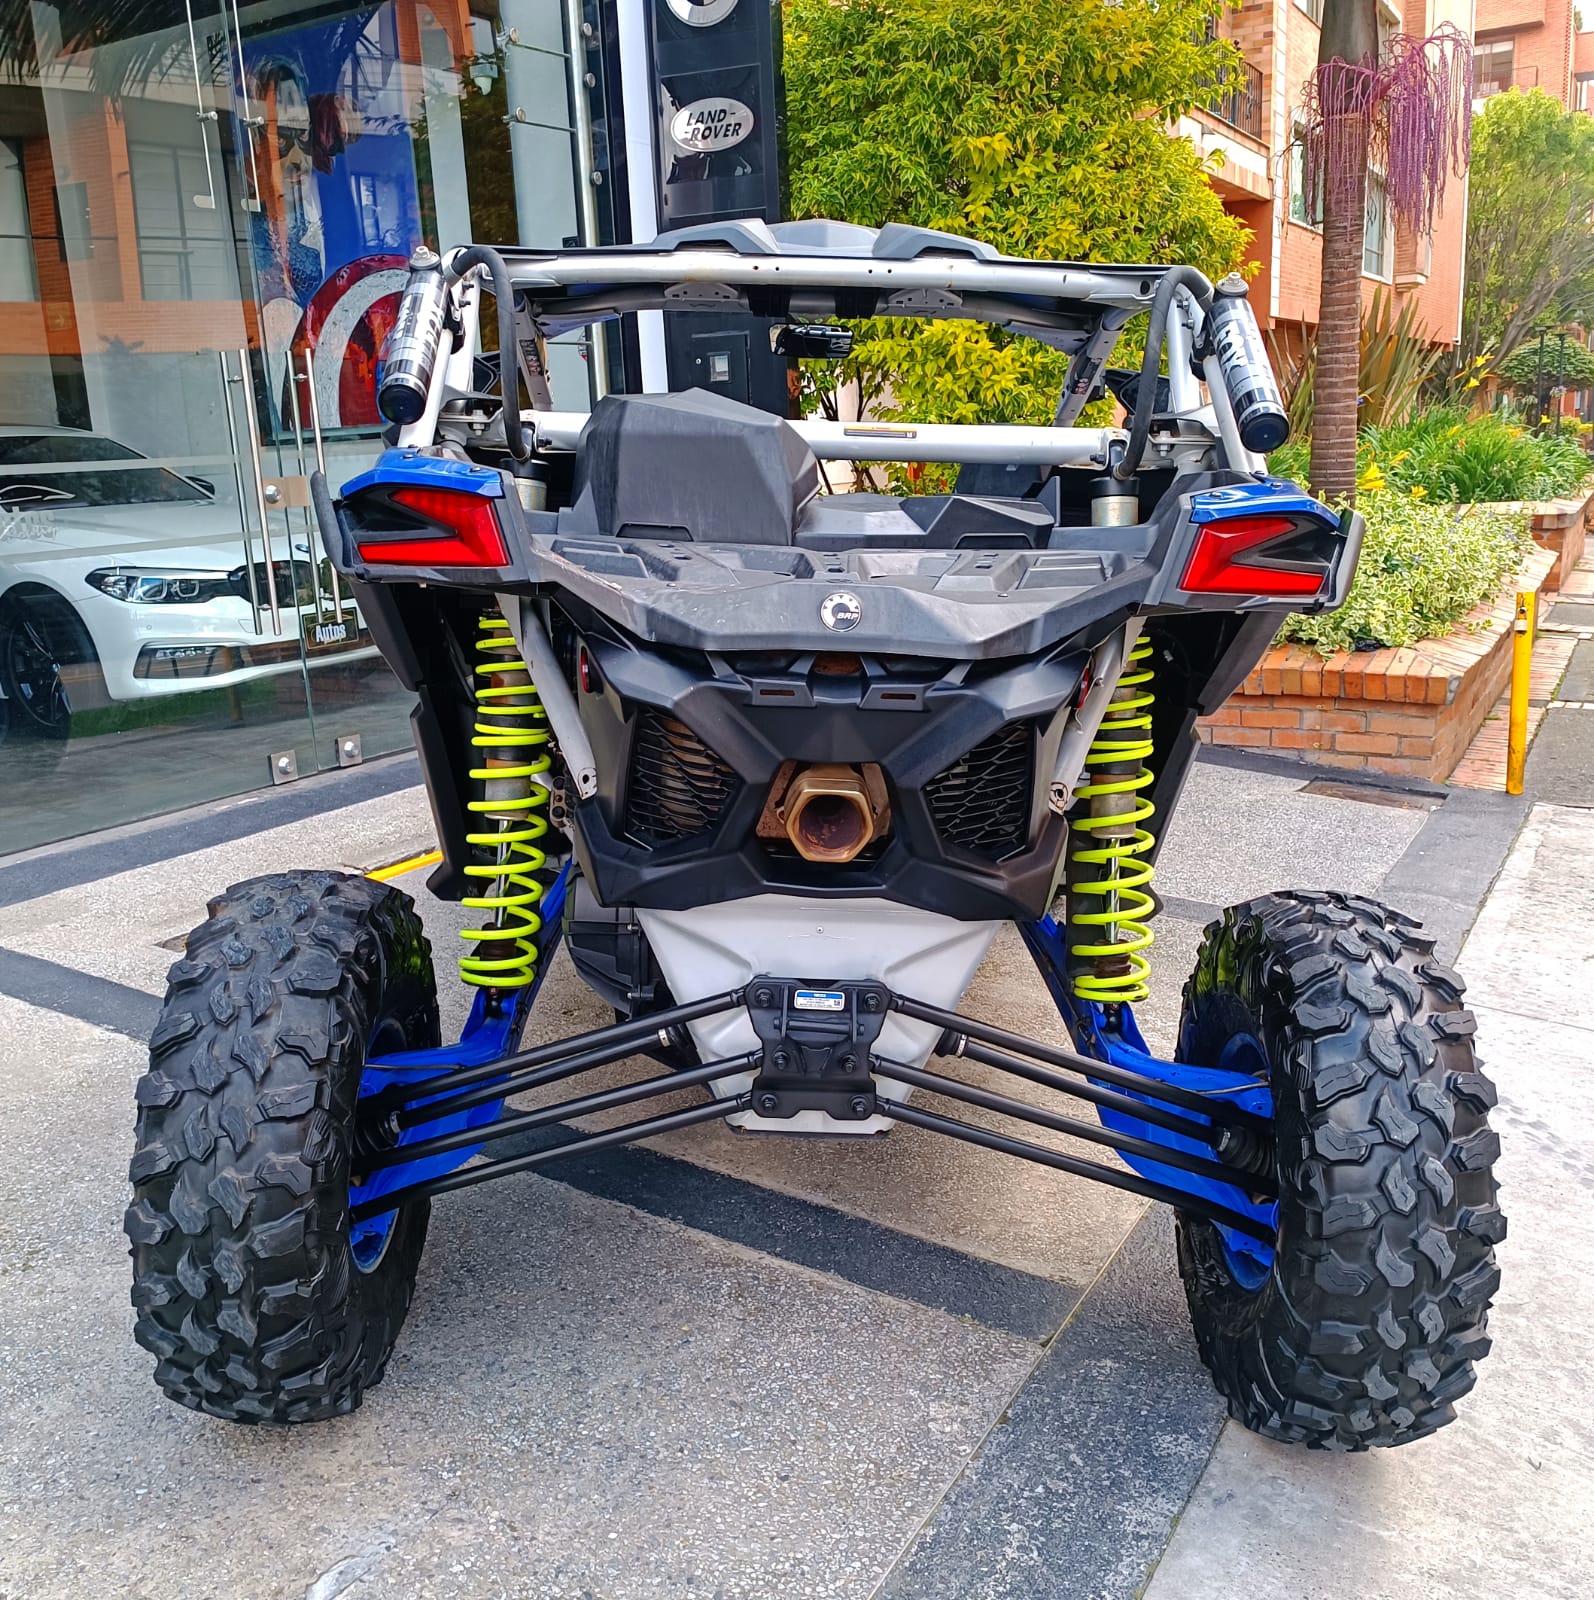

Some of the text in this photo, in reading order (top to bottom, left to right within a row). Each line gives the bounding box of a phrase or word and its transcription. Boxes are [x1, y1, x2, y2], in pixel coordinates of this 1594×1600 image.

[1214, 320, 1248, 377] FOX
[836, 611, 859, 620] BRP
[315, 623, 347, 643] Autos
